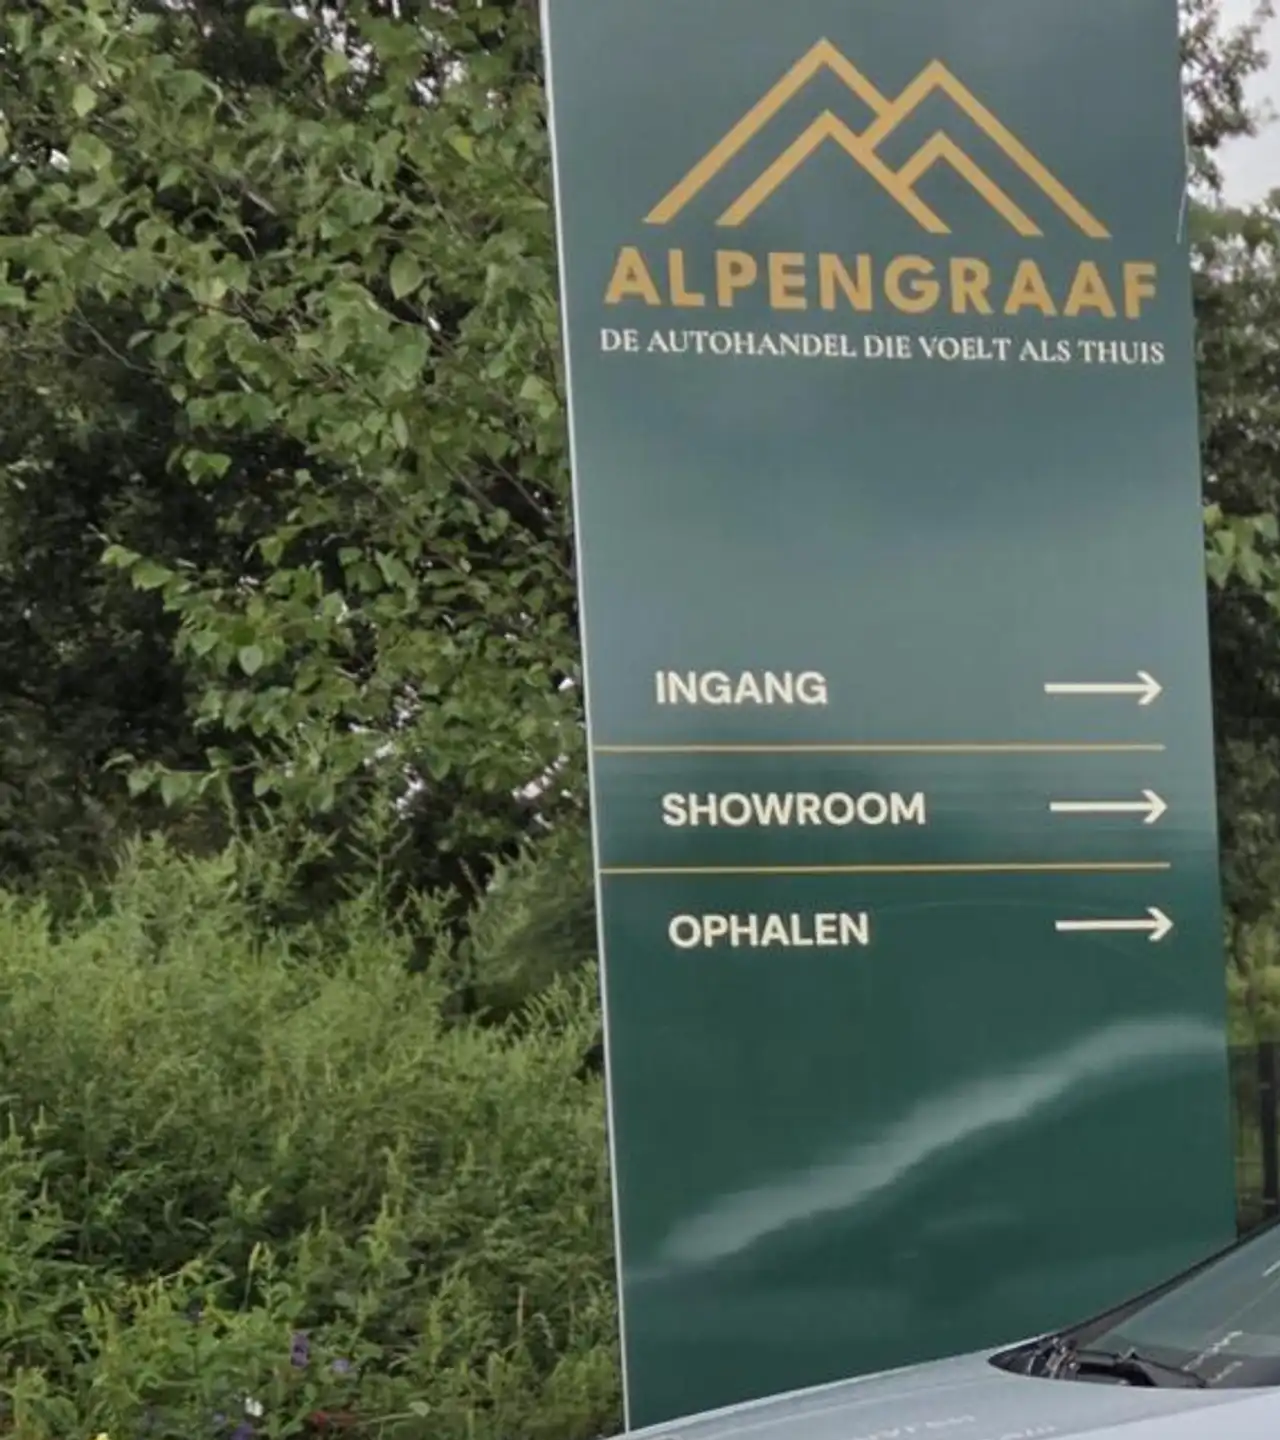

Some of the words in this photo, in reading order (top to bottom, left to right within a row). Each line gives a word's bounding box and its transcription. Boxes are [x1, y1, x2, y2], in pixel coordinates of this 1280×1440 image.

[604, 246, 1158, 319] ALPENGRAAF
[600, 328, 640, 354] DE
[647, 329, 857, 359] AUTOHANDEL
[864, 334, 912, 360] DIE
[918, 335, 1011, 362] VOELT
[1019, 338, 1071, 363] ALS
[1077, 340, 1165, 365] THUIS
[655, 671, 828, 705] INGANG
[662, 792, 926, 826] SHOWROOM
[668, 913, 870, 948] OPHALEN
